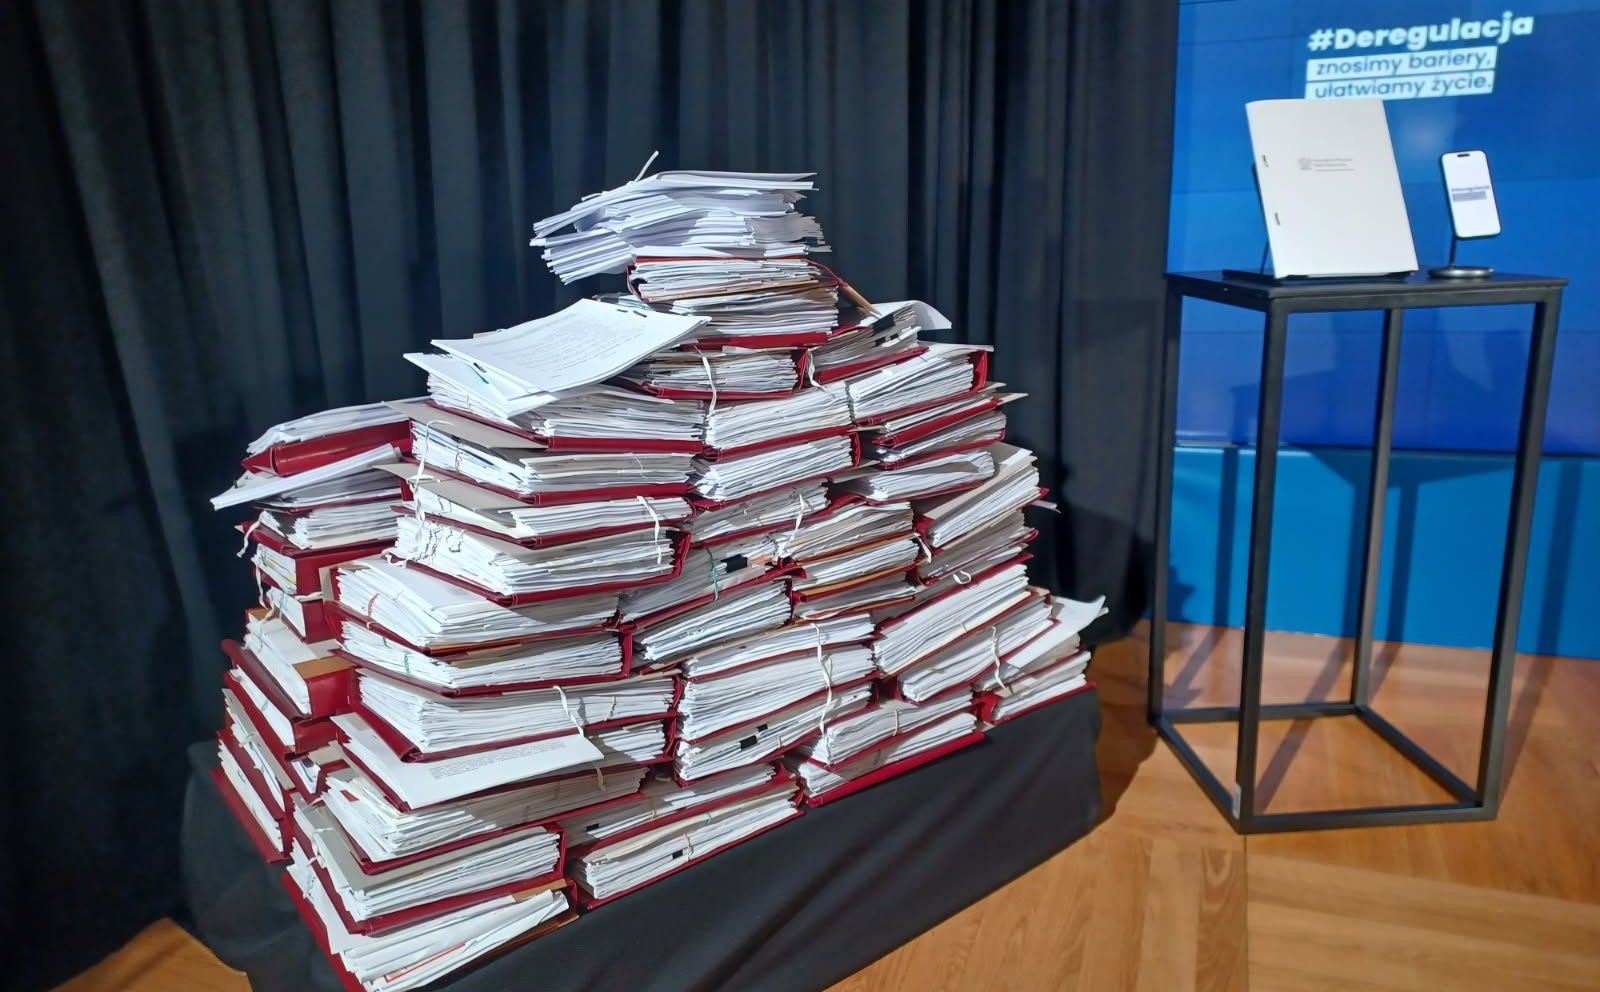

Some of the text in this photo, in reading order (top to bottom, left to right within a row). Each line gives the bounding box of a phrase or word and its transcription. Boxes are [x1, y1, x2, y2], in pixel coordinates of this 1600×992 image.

[1308, 11, 1534, 50] #Deregulacja
[1316, 56, 1403, 76] znosimy
[1432, 73, 1492, 96] życie.
